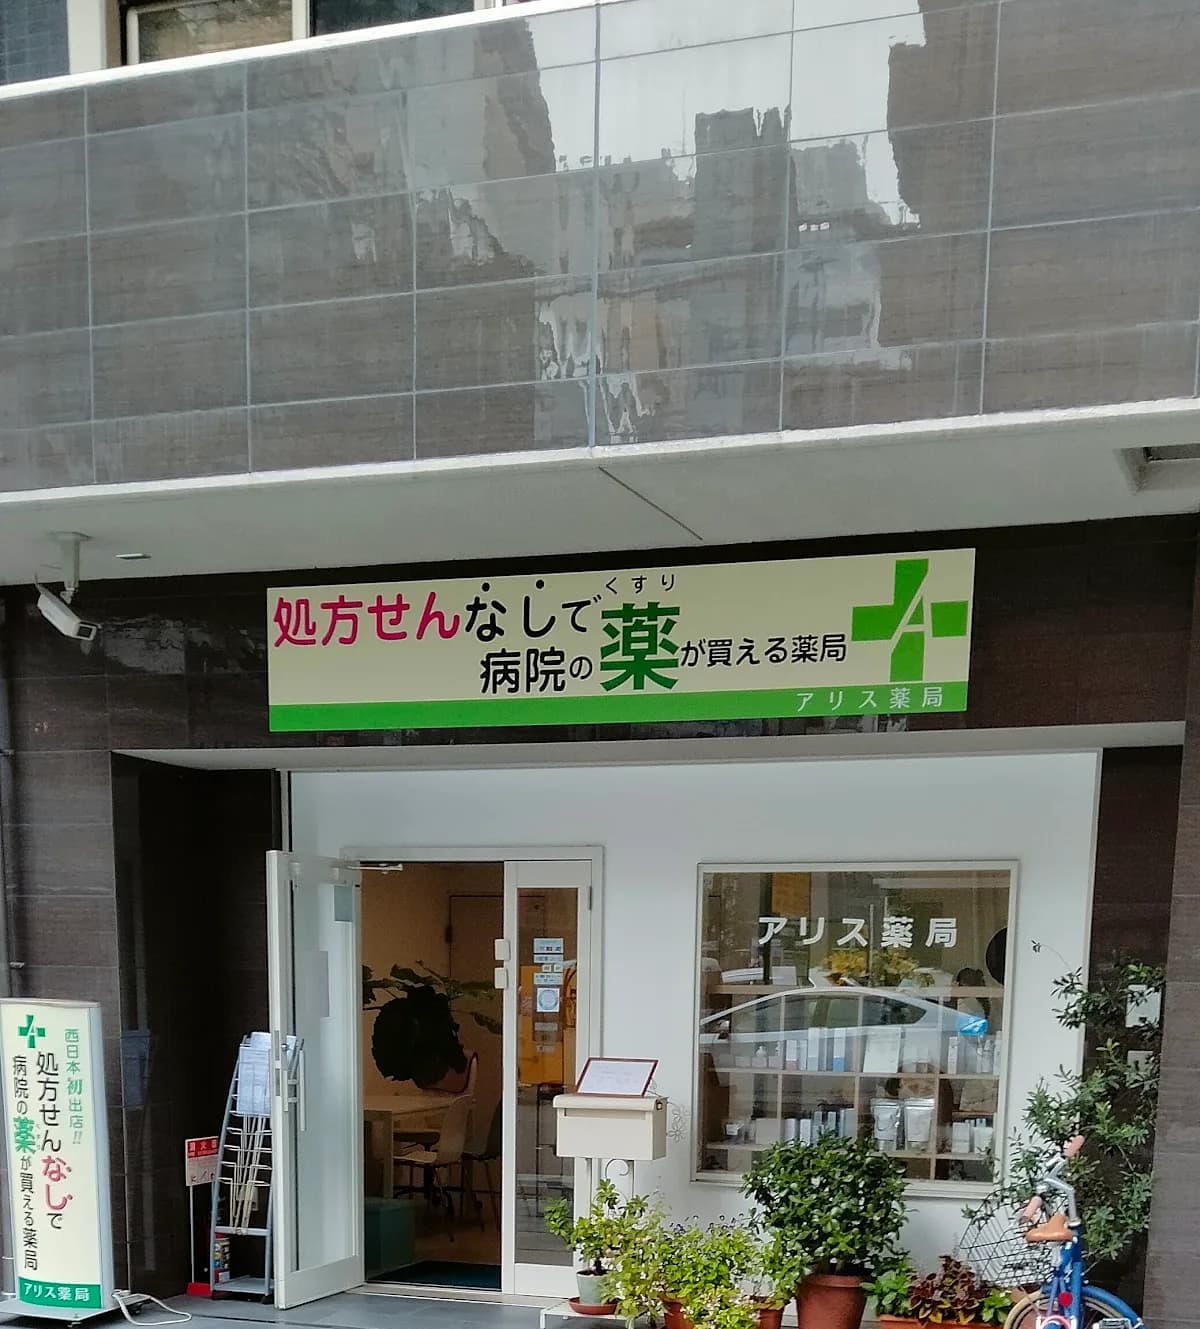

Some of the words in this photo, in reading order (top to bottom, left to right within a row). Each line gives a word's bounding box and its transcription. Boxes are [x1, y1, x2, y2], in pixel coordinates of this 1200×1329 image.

[605, 573, 676, 595] くすり
[273, 591, 602, 648] 処方せんなしで
[796, 686, 943, 713] アリス薬局
[758, 916, 958, 949] アリス薬局
[23, 1282, 90, 1302] アリス薬局
